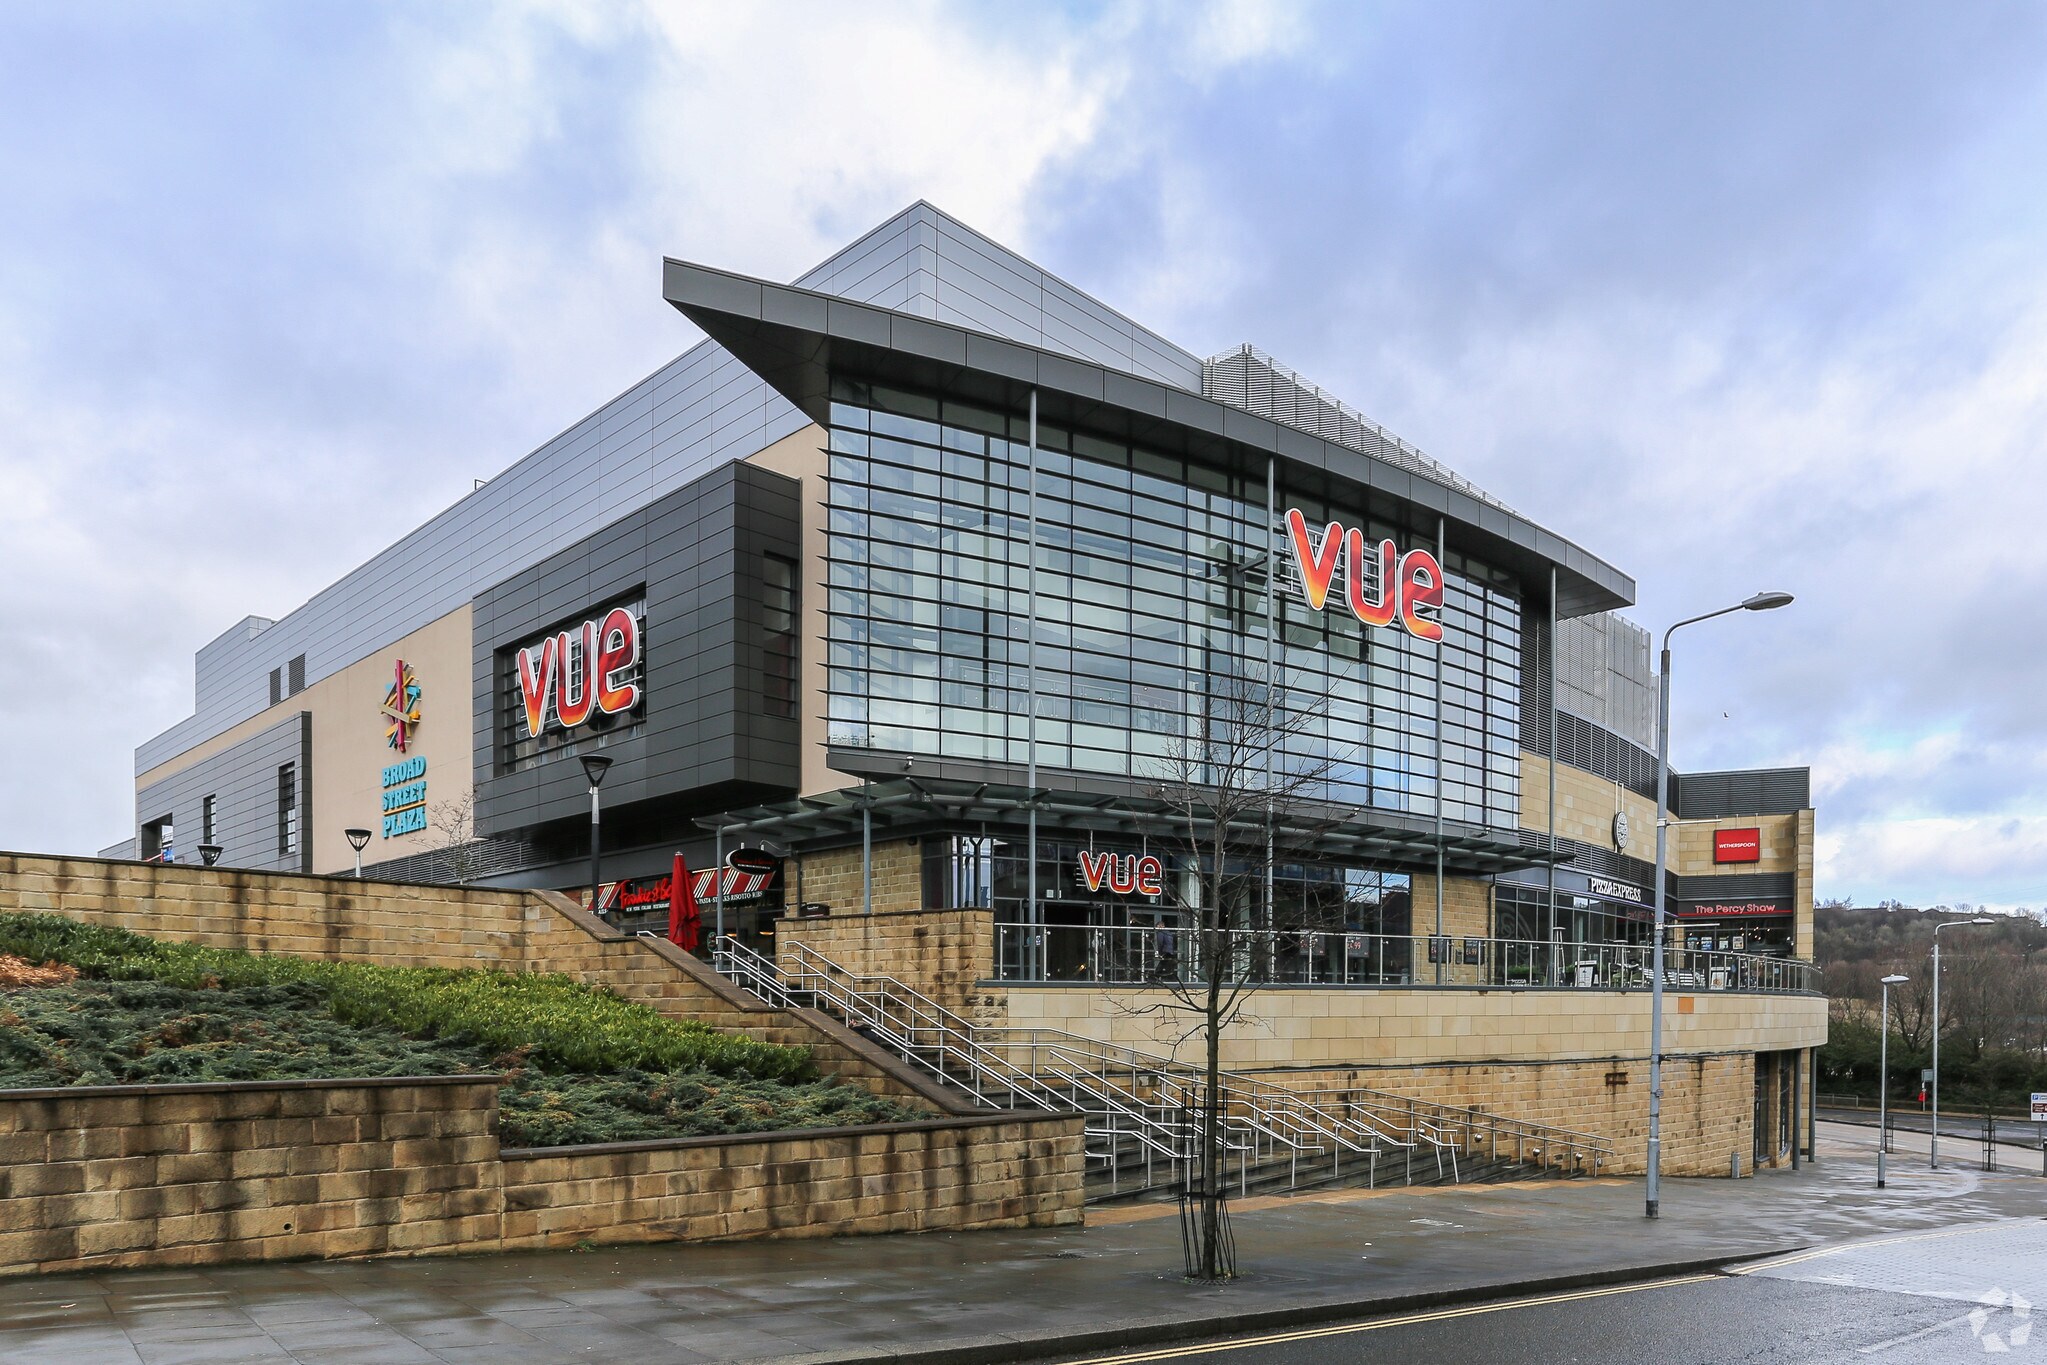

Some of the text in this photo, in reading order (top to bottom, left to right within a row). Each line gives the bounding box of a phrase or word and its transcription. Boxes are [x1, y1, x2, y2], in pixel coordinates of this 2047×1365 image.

[382, 756, 427, 788] BROAD
[382, 781, 427, 812] STREET
[382, 806, 427, 839] PLAZA
[1591, 877, 1642, 902] PIZZAEXPRESS
[1695, 903, 1776, 914] The Percy Shaw
